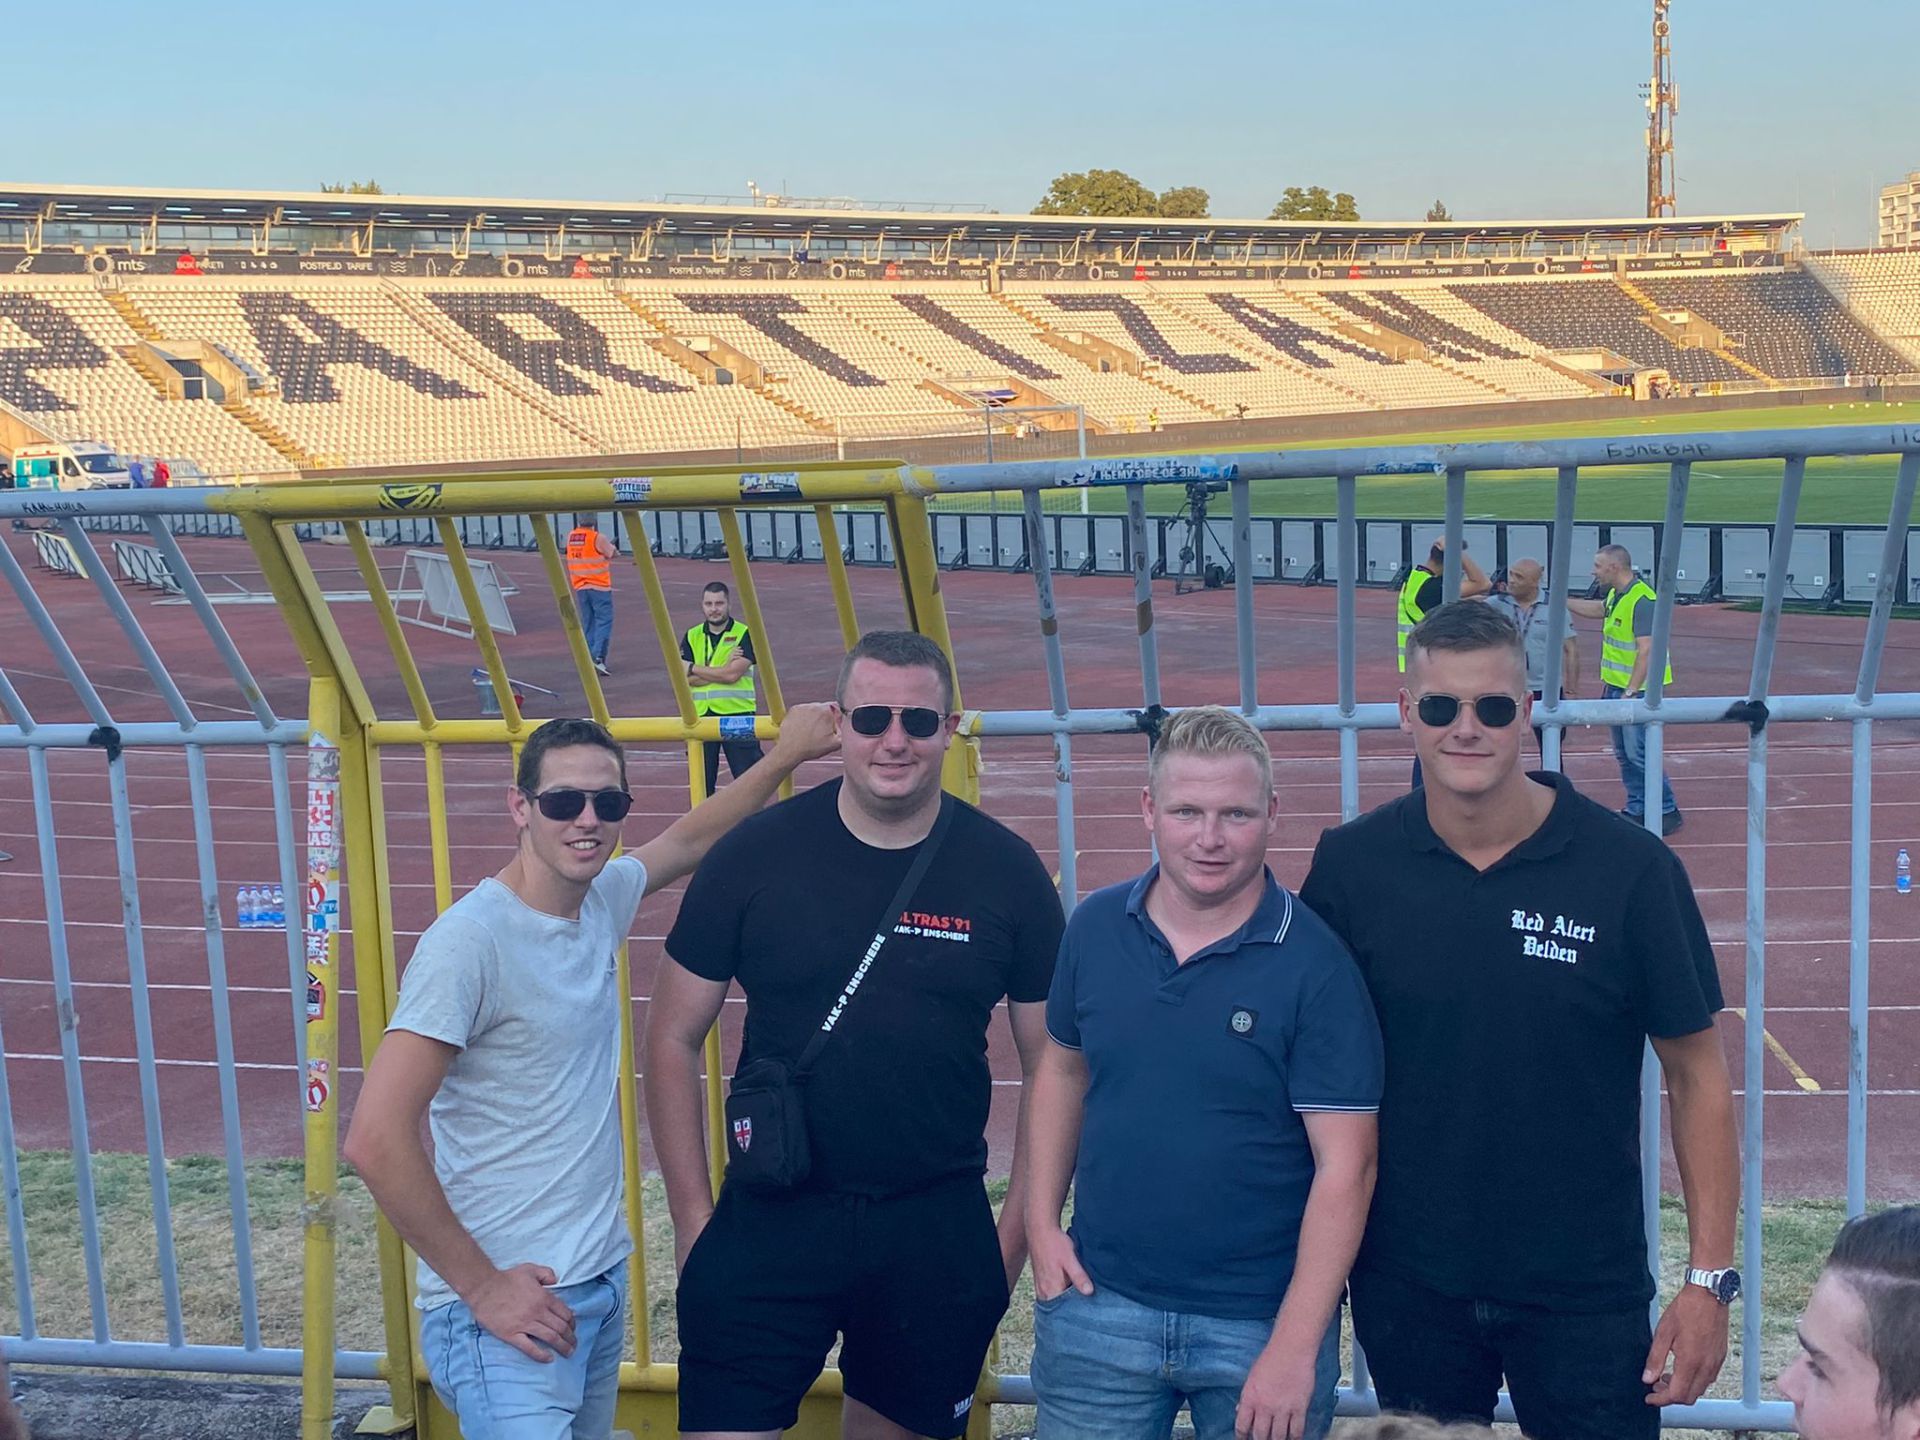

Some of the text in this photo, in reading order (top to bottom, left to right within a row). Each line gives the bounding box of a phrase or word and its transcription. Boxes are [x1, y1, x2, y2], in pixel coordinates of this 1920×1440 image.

[117, 259, 146, 271] mts
[346, 261, 373, 271] TARIFE
[527, 264, 549, 275] mts
[1550, 263, 1566, 273] mts
[848, 268, 866, 278] mts
[1104, 269, 1119, 279] mts
[1322, 269, 1336, 278] mts
[900, 911, 971, 931] LTRAS'91
[1511, 909, 1596, 943] Red Alert
[923, 929, 971, 943] ENSCHEDE
[1523, 935, 1578, 964] Delden
[821, 933, 886, 1033] VAK-P ENSCHEDE
